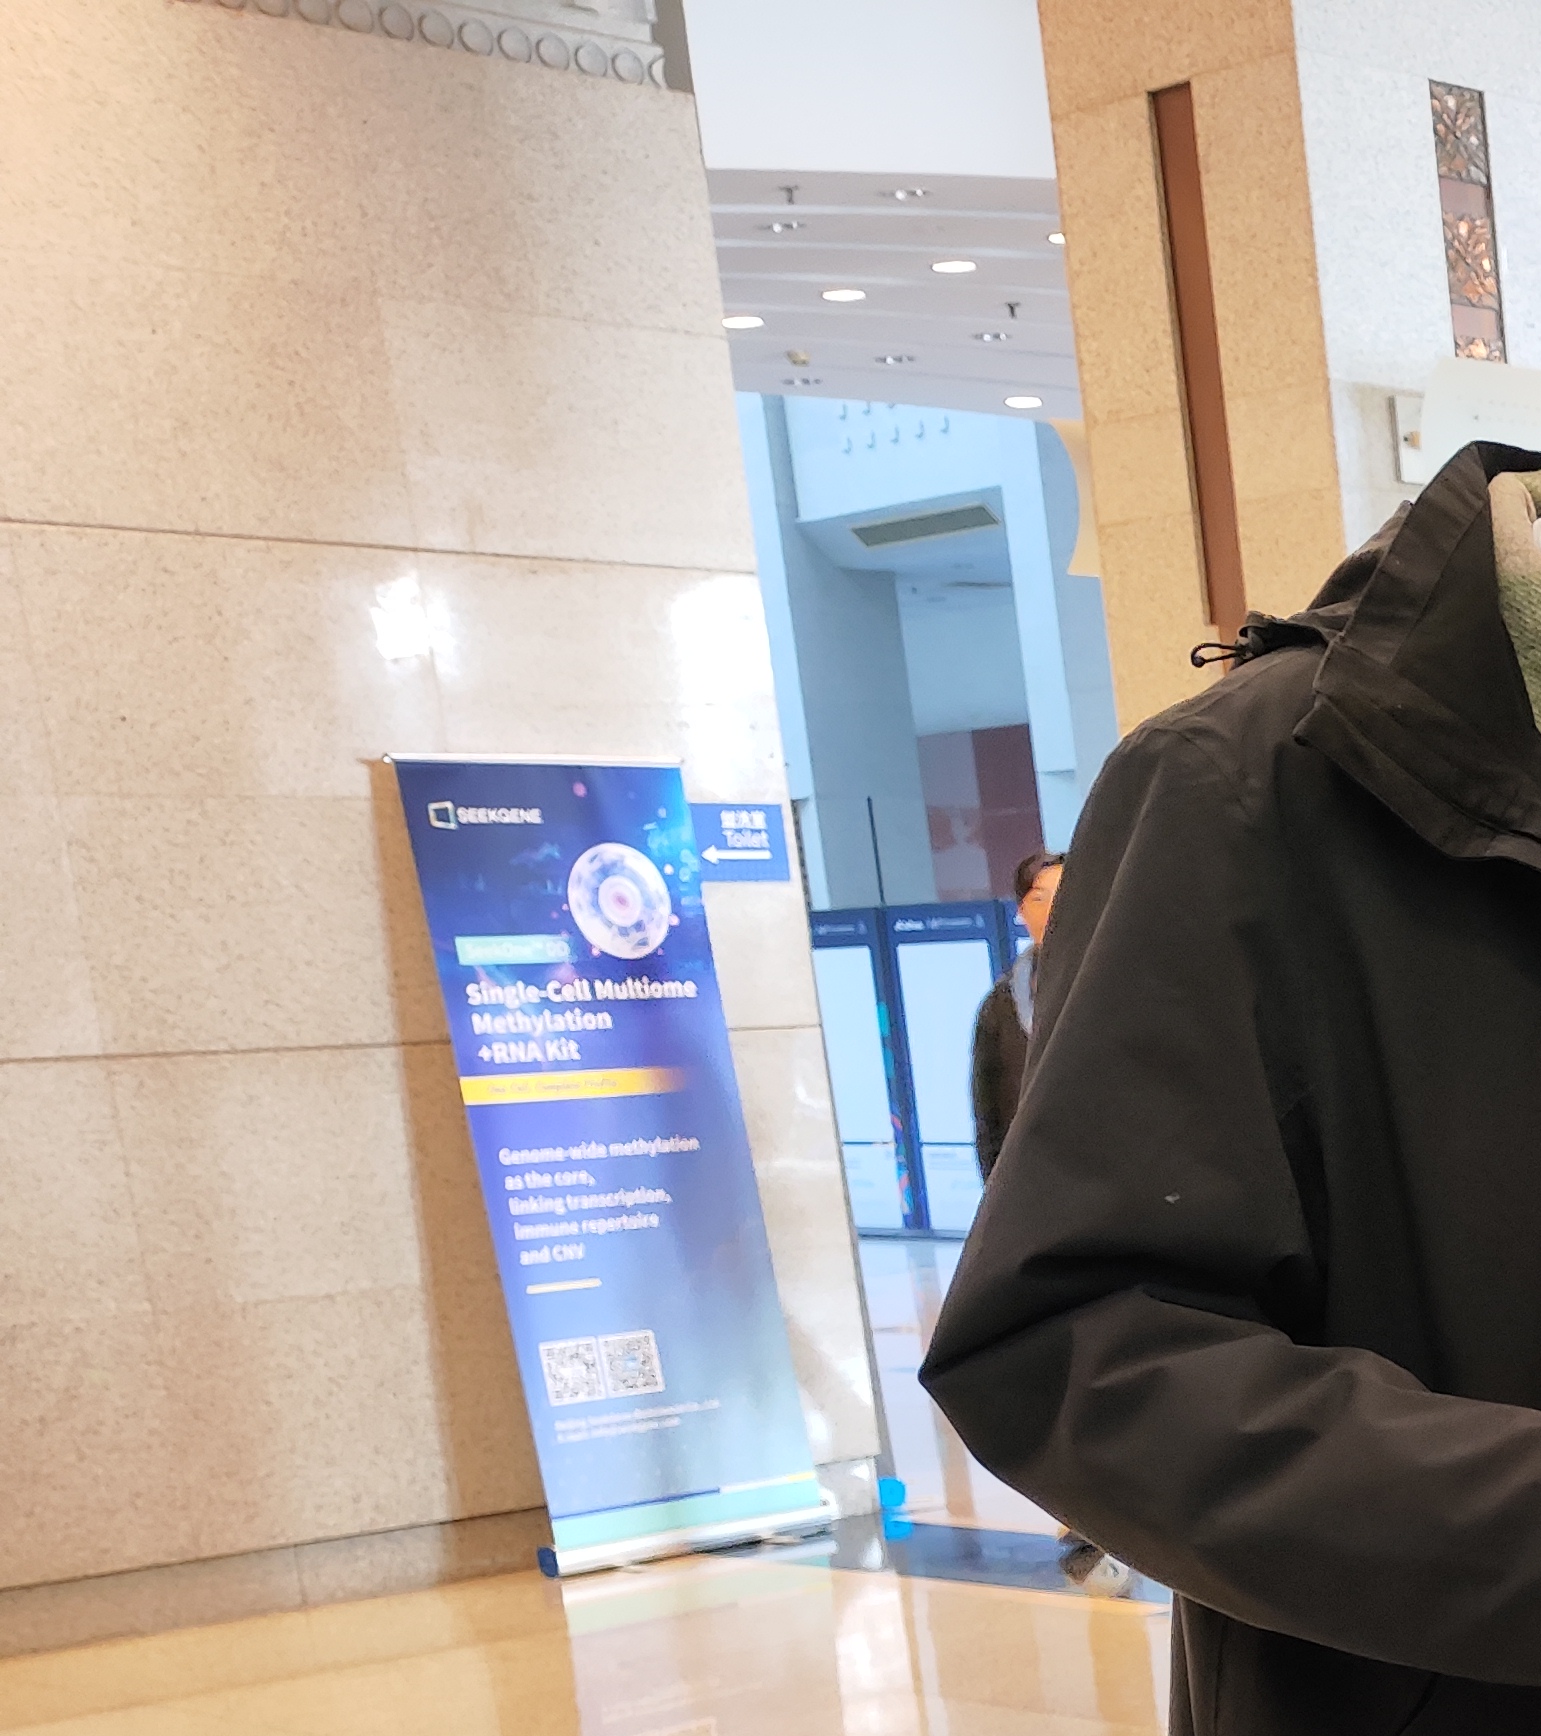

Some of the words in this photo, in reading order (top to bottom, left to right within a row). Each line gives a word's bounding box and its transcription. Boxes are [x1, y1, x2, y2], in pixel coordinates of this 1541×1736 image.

[456, 807, 543, 825] SEEKGENE
[722, 828, 770, 848] Toilet
[466, 977, 592, 1009] Single-Cell
[594, 975, 699, 1000] Multiome
[471, 1007, 614, 1036] Methylation
[478, 1040, 543, 1064] +RNA
[545, 1036, 582, 1061] Kit
[498, 1140, 608, 1166] Genome-wide
[608, 1134, 700, 1158] methylation
[504, 1175, 524, 1191] as
[525, 1170, 550, 1189] the
[508, 1194, 565, 1216] linking
[565, 1186, 674, 1211] transcription,
[581, 1212, 660, 1236] repertoire
[519, 1245, 550, 1266] and
[551, 1241, 585, 1263] CNV
